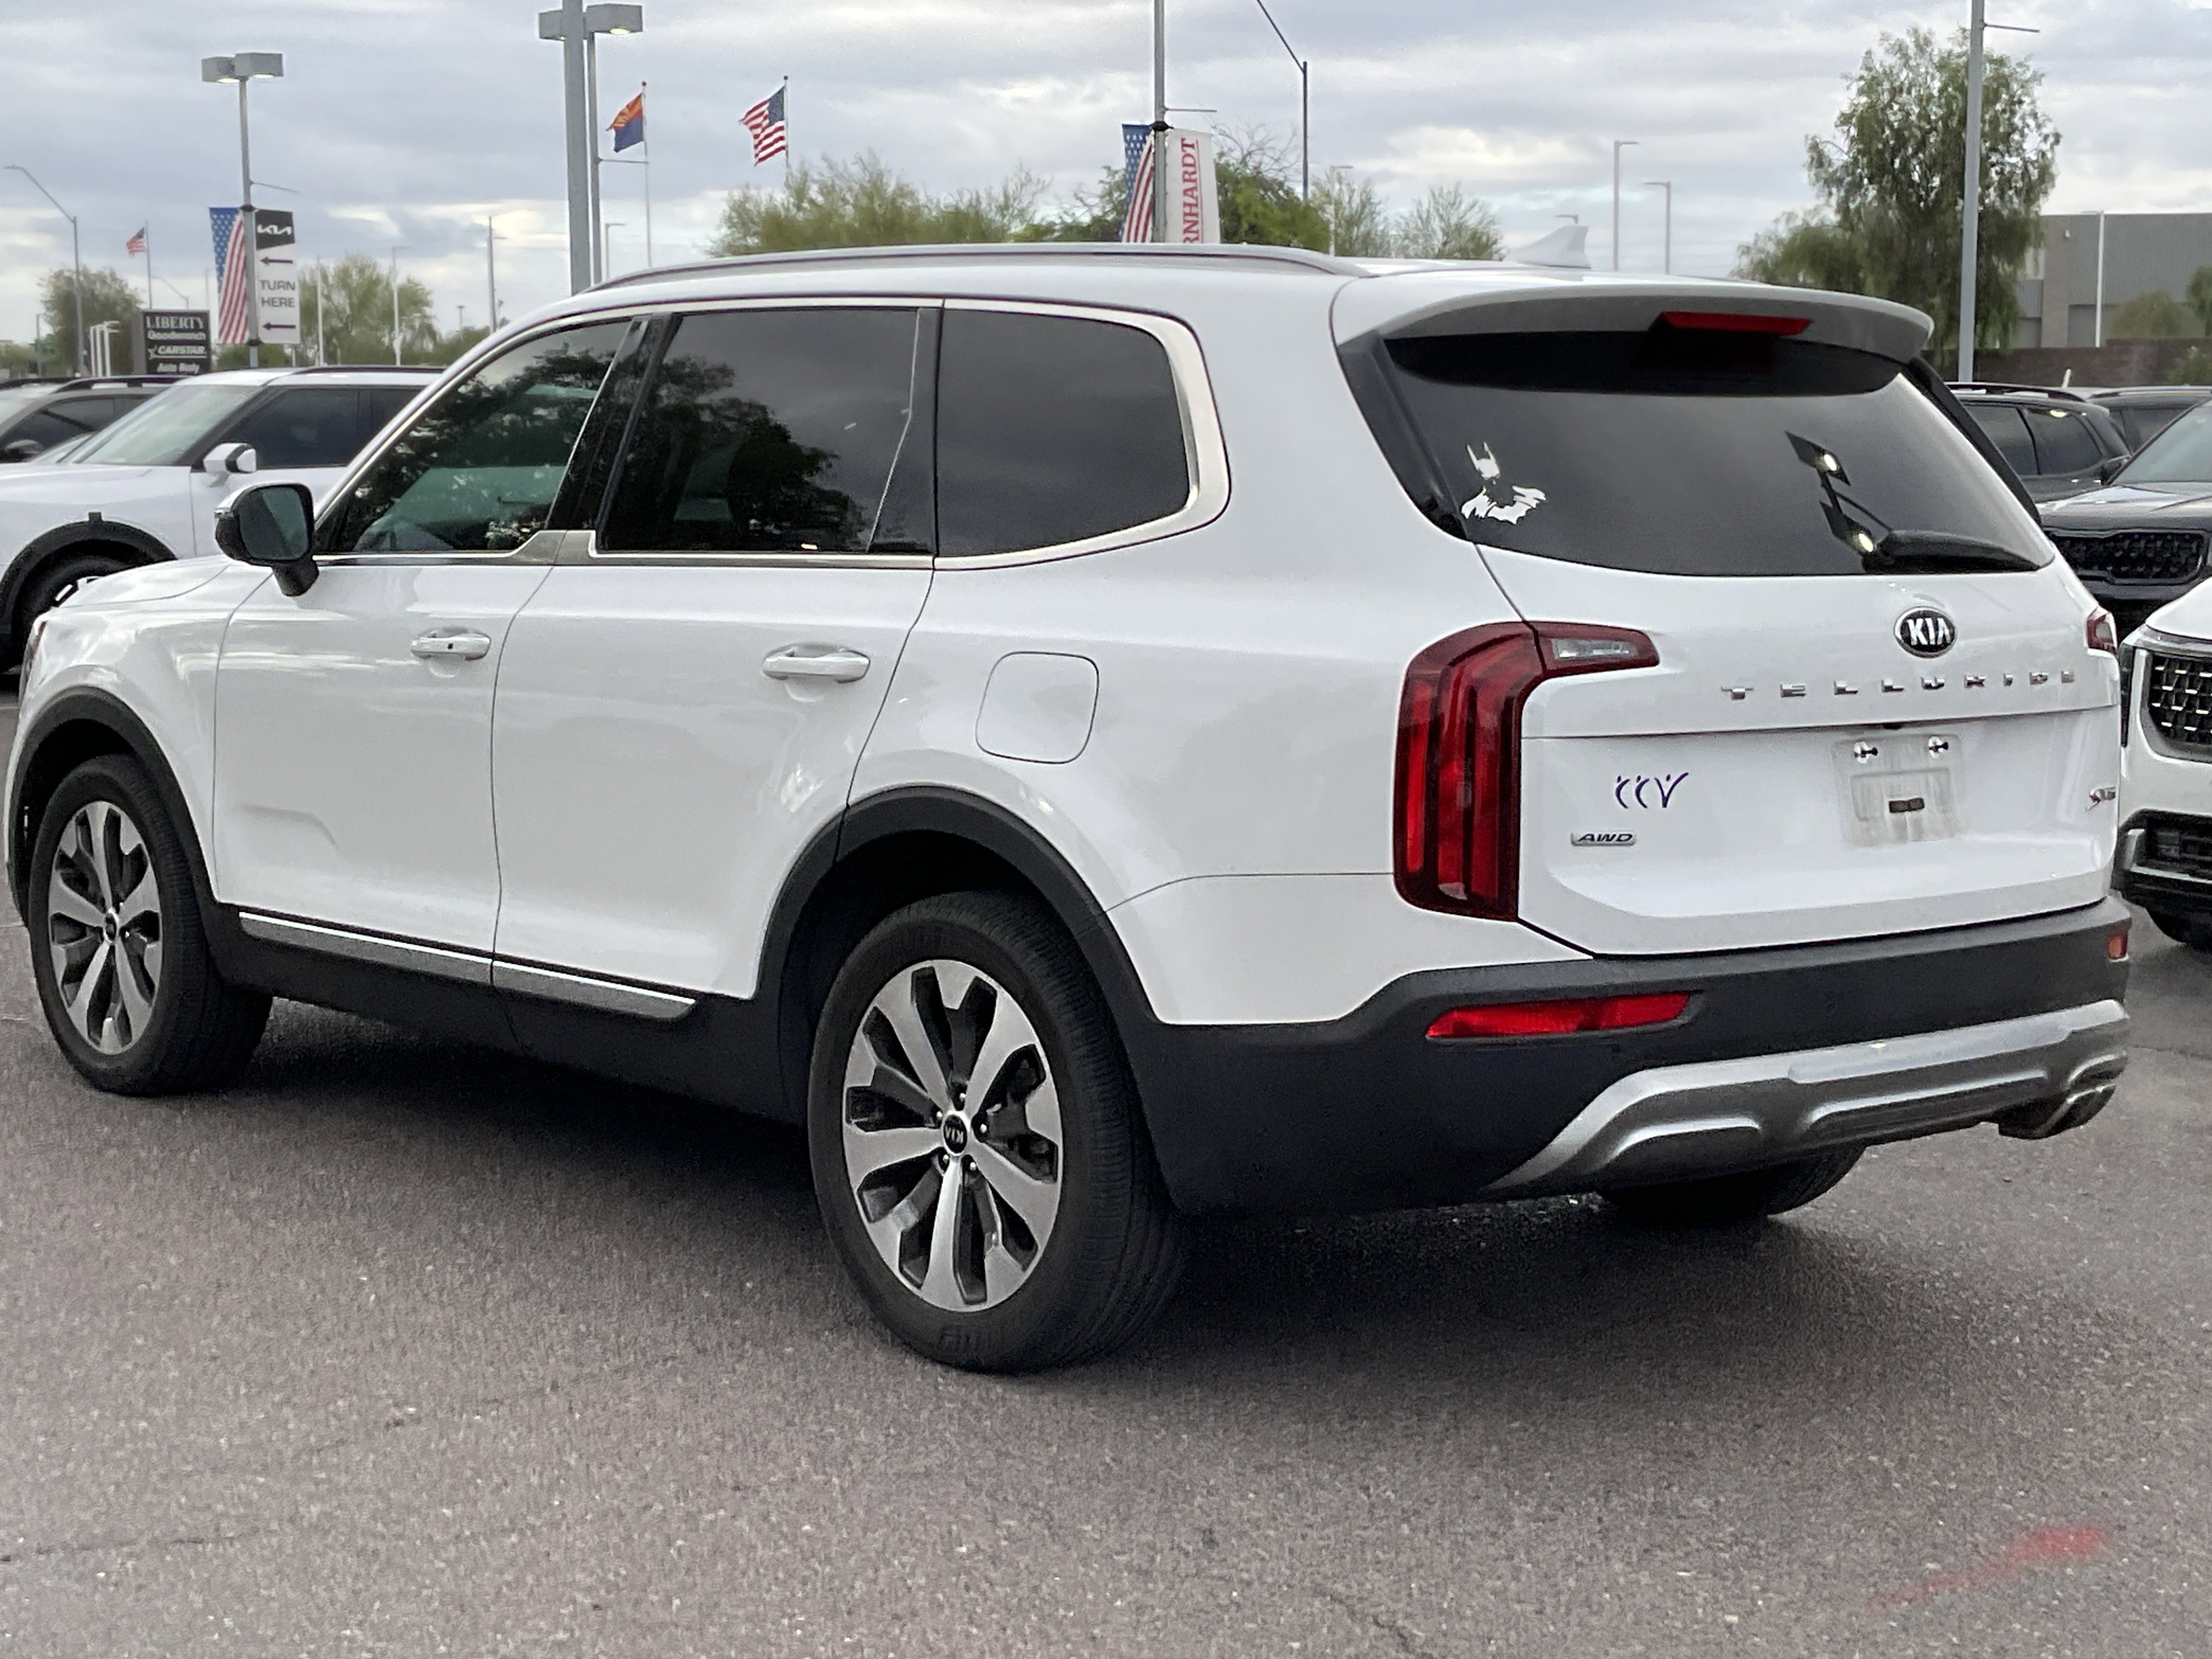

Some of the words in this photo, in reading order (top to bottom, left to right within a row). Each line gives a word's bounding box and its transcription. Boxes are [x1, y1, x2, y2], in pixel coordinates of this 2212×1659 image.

[259, 280, 296, 291] TURN
[261, 297, 296, 308] HERE
[145, 316, 204, 329] LIBERTY
[1906, 617, 1950, 646] KIA
[1720, 670, 2075, 700] TELLURIDE
[1577, 833, 1634, 842] AWD
[945, 1125, 964, 1144] KIA
